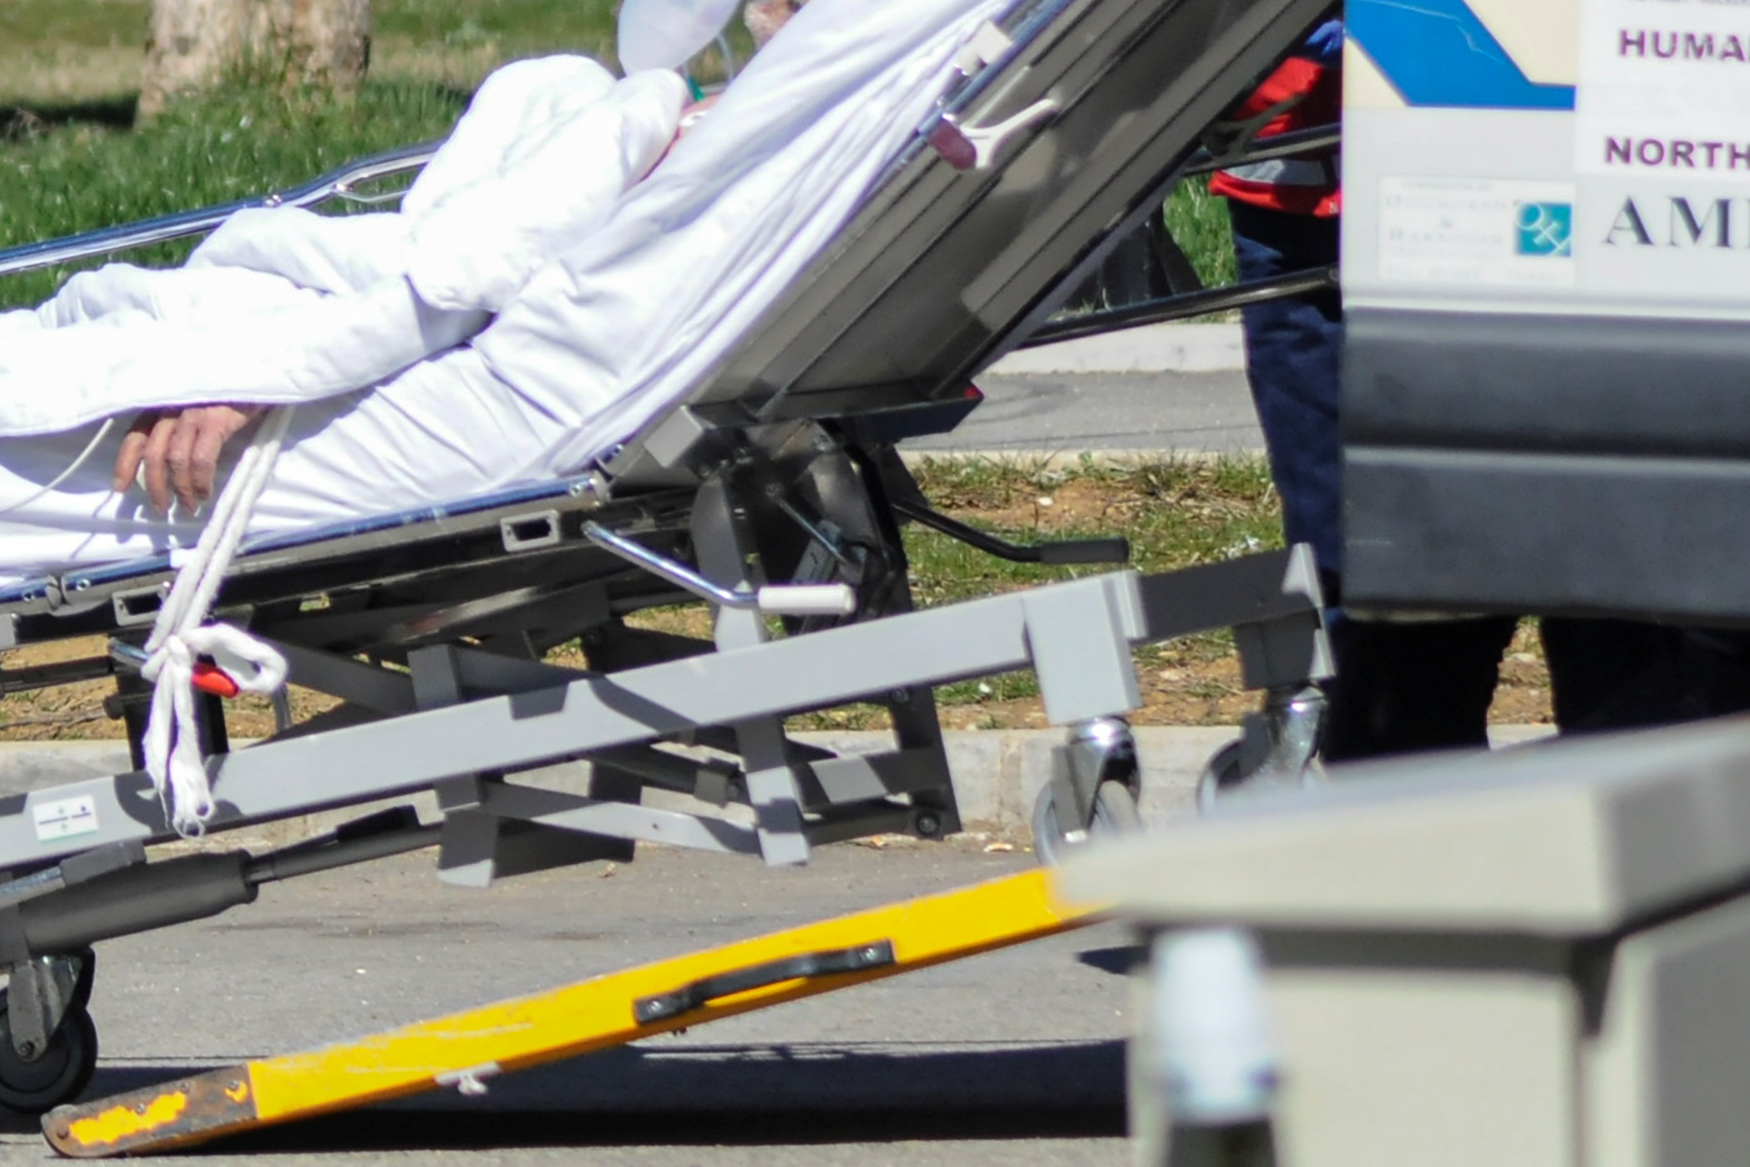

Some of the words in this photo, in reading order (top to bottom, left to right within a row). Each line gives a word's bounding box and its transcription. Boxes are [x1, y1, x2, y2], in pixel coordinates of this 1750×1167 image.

[1619, 28, 1750, 63] HUMA
[1604, 135, 1750, 170] NORTH
[1601, 194, 1750, 249] AM
